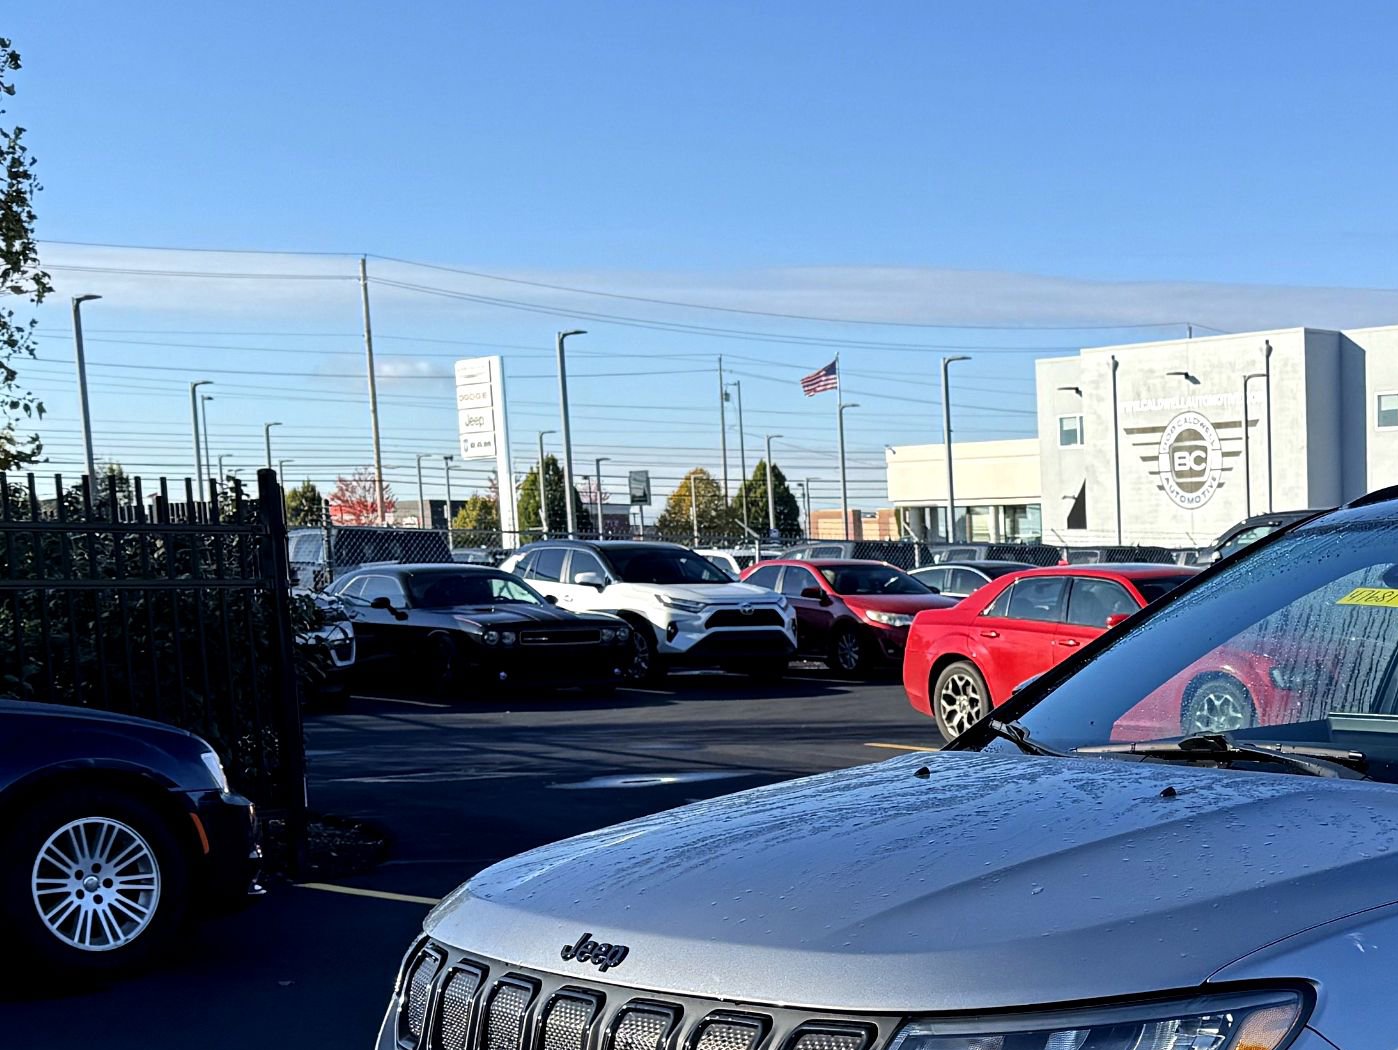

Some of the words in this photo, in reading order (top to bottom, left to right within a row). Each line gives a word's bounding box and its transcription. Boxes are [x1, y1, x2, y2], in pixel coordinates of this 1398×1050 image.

[459, 392, 488, 402] DODGE
[465, 415, 485, 427] Jeep
[1176, 417, 1216, 447] CALDWELL
[1174, 450, 1207, 472] BC
[1164, 476, 1217, 505] AUTOMOTIVE
[561, 932, 630, 973] Jeep
